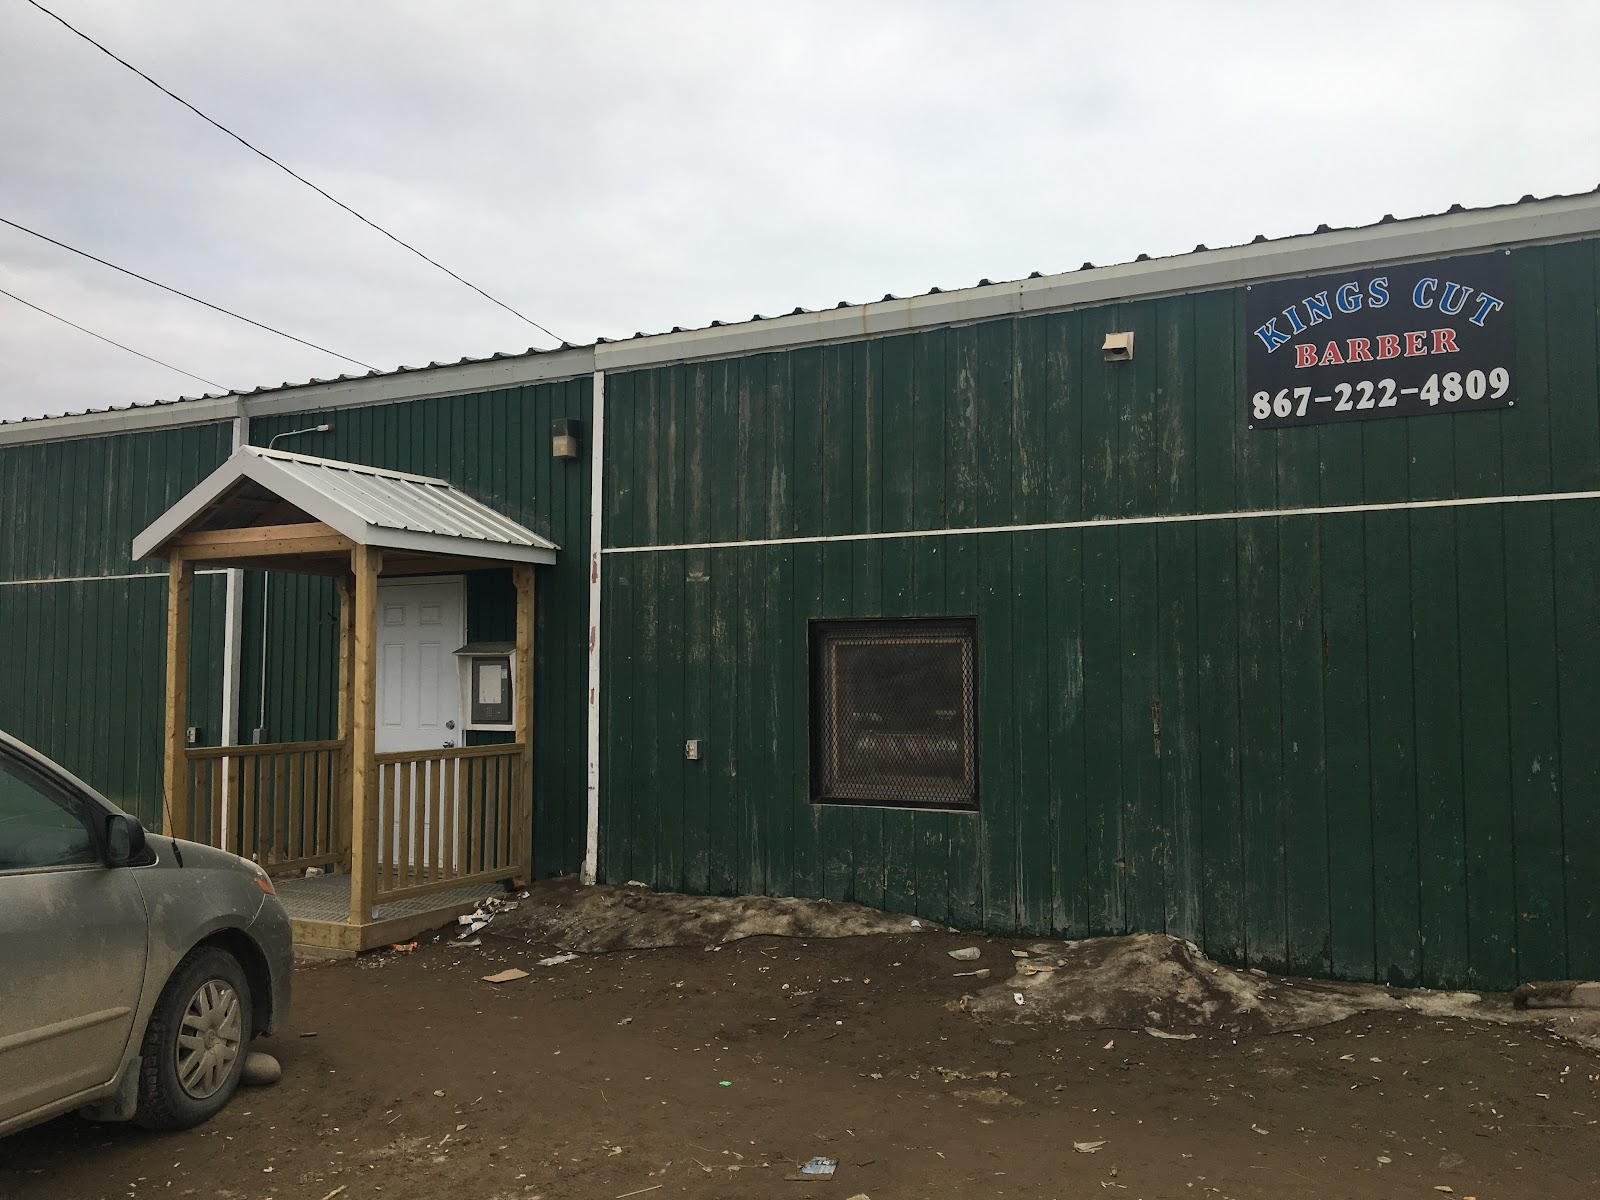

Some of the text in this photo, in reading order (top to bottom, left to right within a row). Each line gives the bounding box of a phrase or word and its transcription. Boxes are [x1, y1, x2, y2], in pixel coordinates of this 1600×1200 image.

[1254, 277, 1504, 353] KINGS CUT
[1294, 328, 1460, 368] BARBER
[1252, 367, 1510, 420] 867-222-4809
